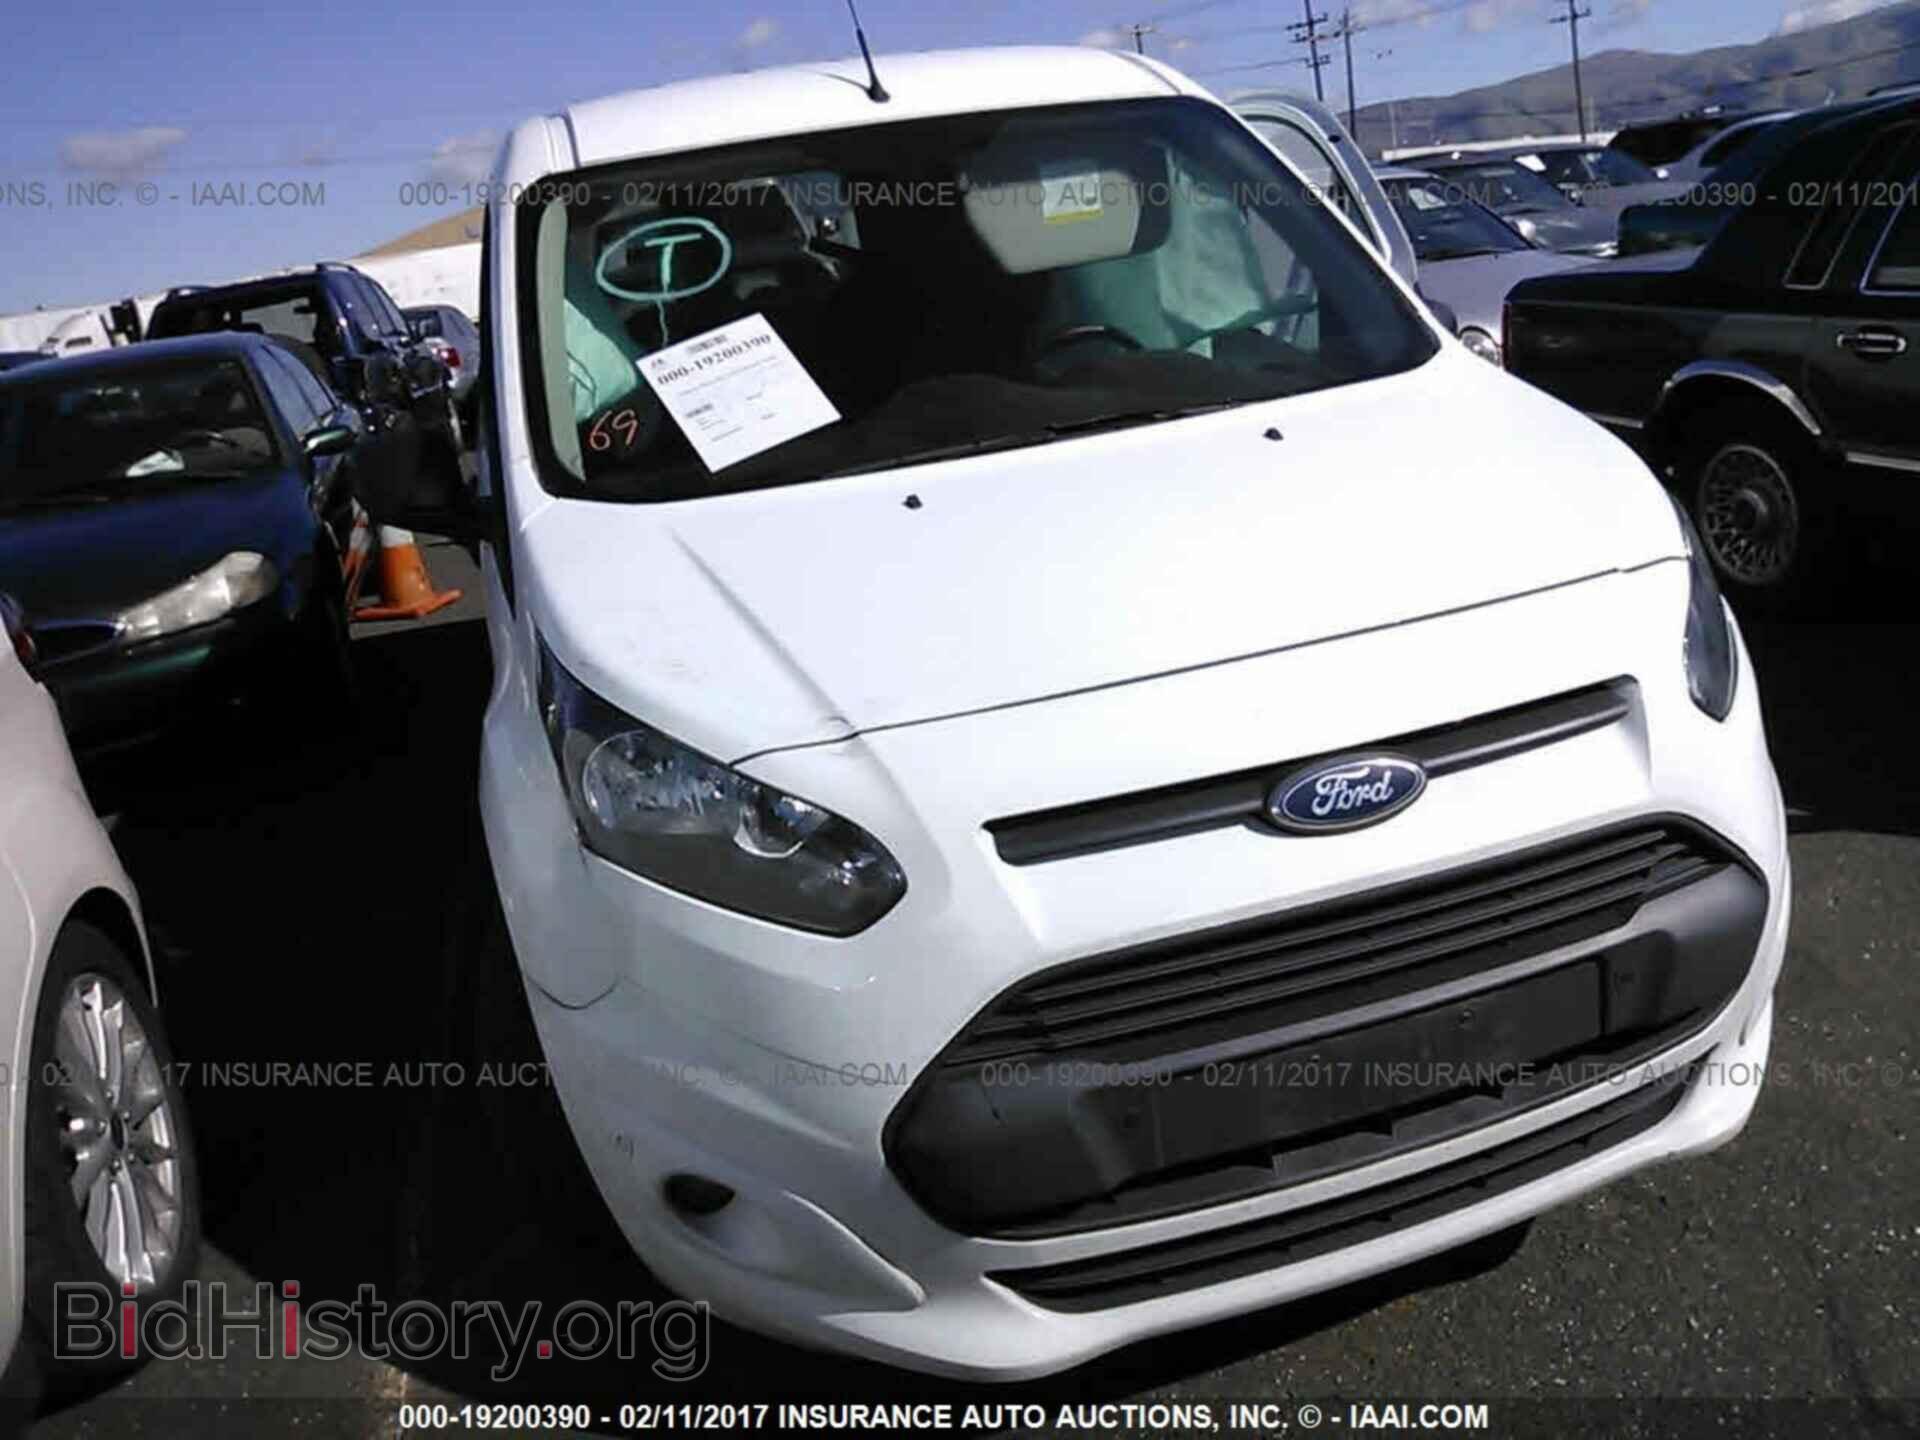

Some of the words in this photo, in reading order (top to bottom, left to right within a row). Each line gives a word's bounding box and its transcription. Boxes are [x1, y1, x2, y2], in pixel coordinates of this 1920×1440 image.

[644, 232, 702, 297] T
[656, 333, 773, 387] 000-19200390
[588, 408, 639, 450] 69
[1311, 765, 1394, 816] Ford
